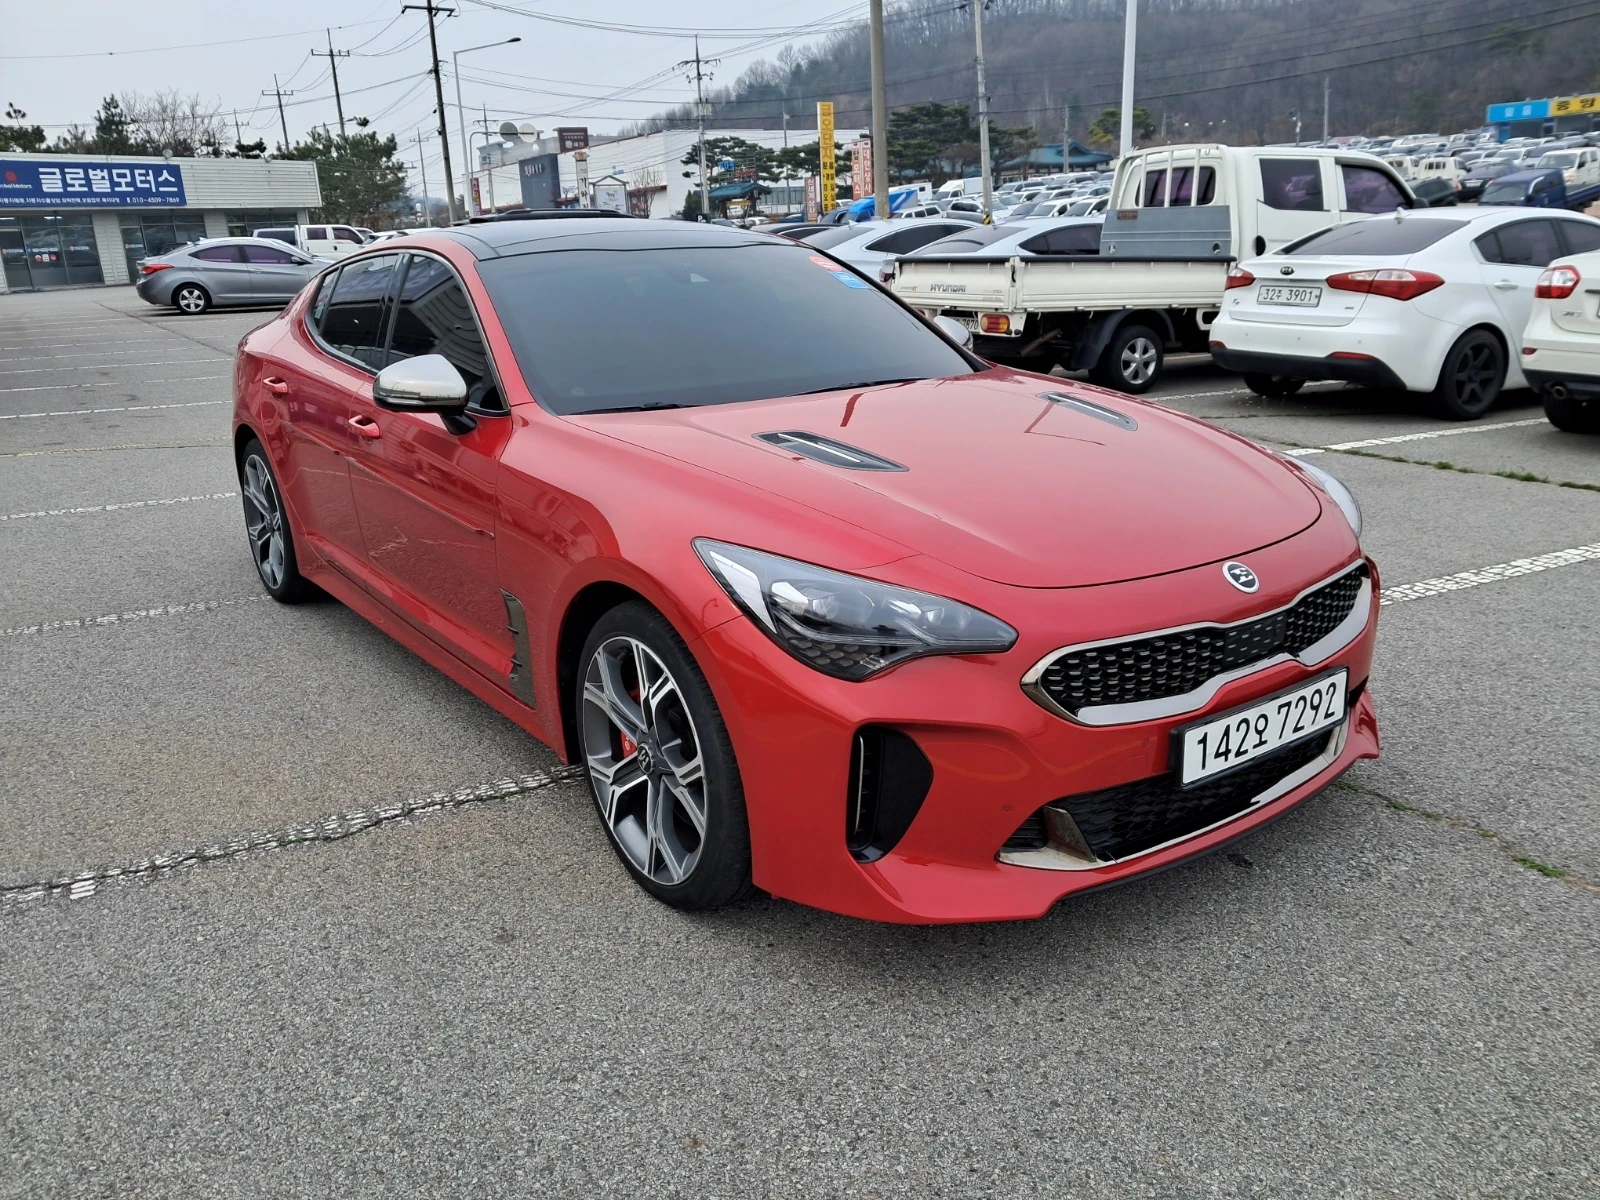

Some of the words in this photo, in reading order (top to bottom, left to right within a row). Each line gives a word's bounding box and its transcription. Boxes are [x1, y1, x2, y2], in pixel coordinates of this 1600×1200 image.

[38, 167, 179, 193] 글로벌모터스
[930, 283, 967, 293] HYUNDAI
[1286, 289, 1314, 302] 3901
[1197, 713, 1269, 771] 142오
[1277, 681, 1337, 740] 7292
